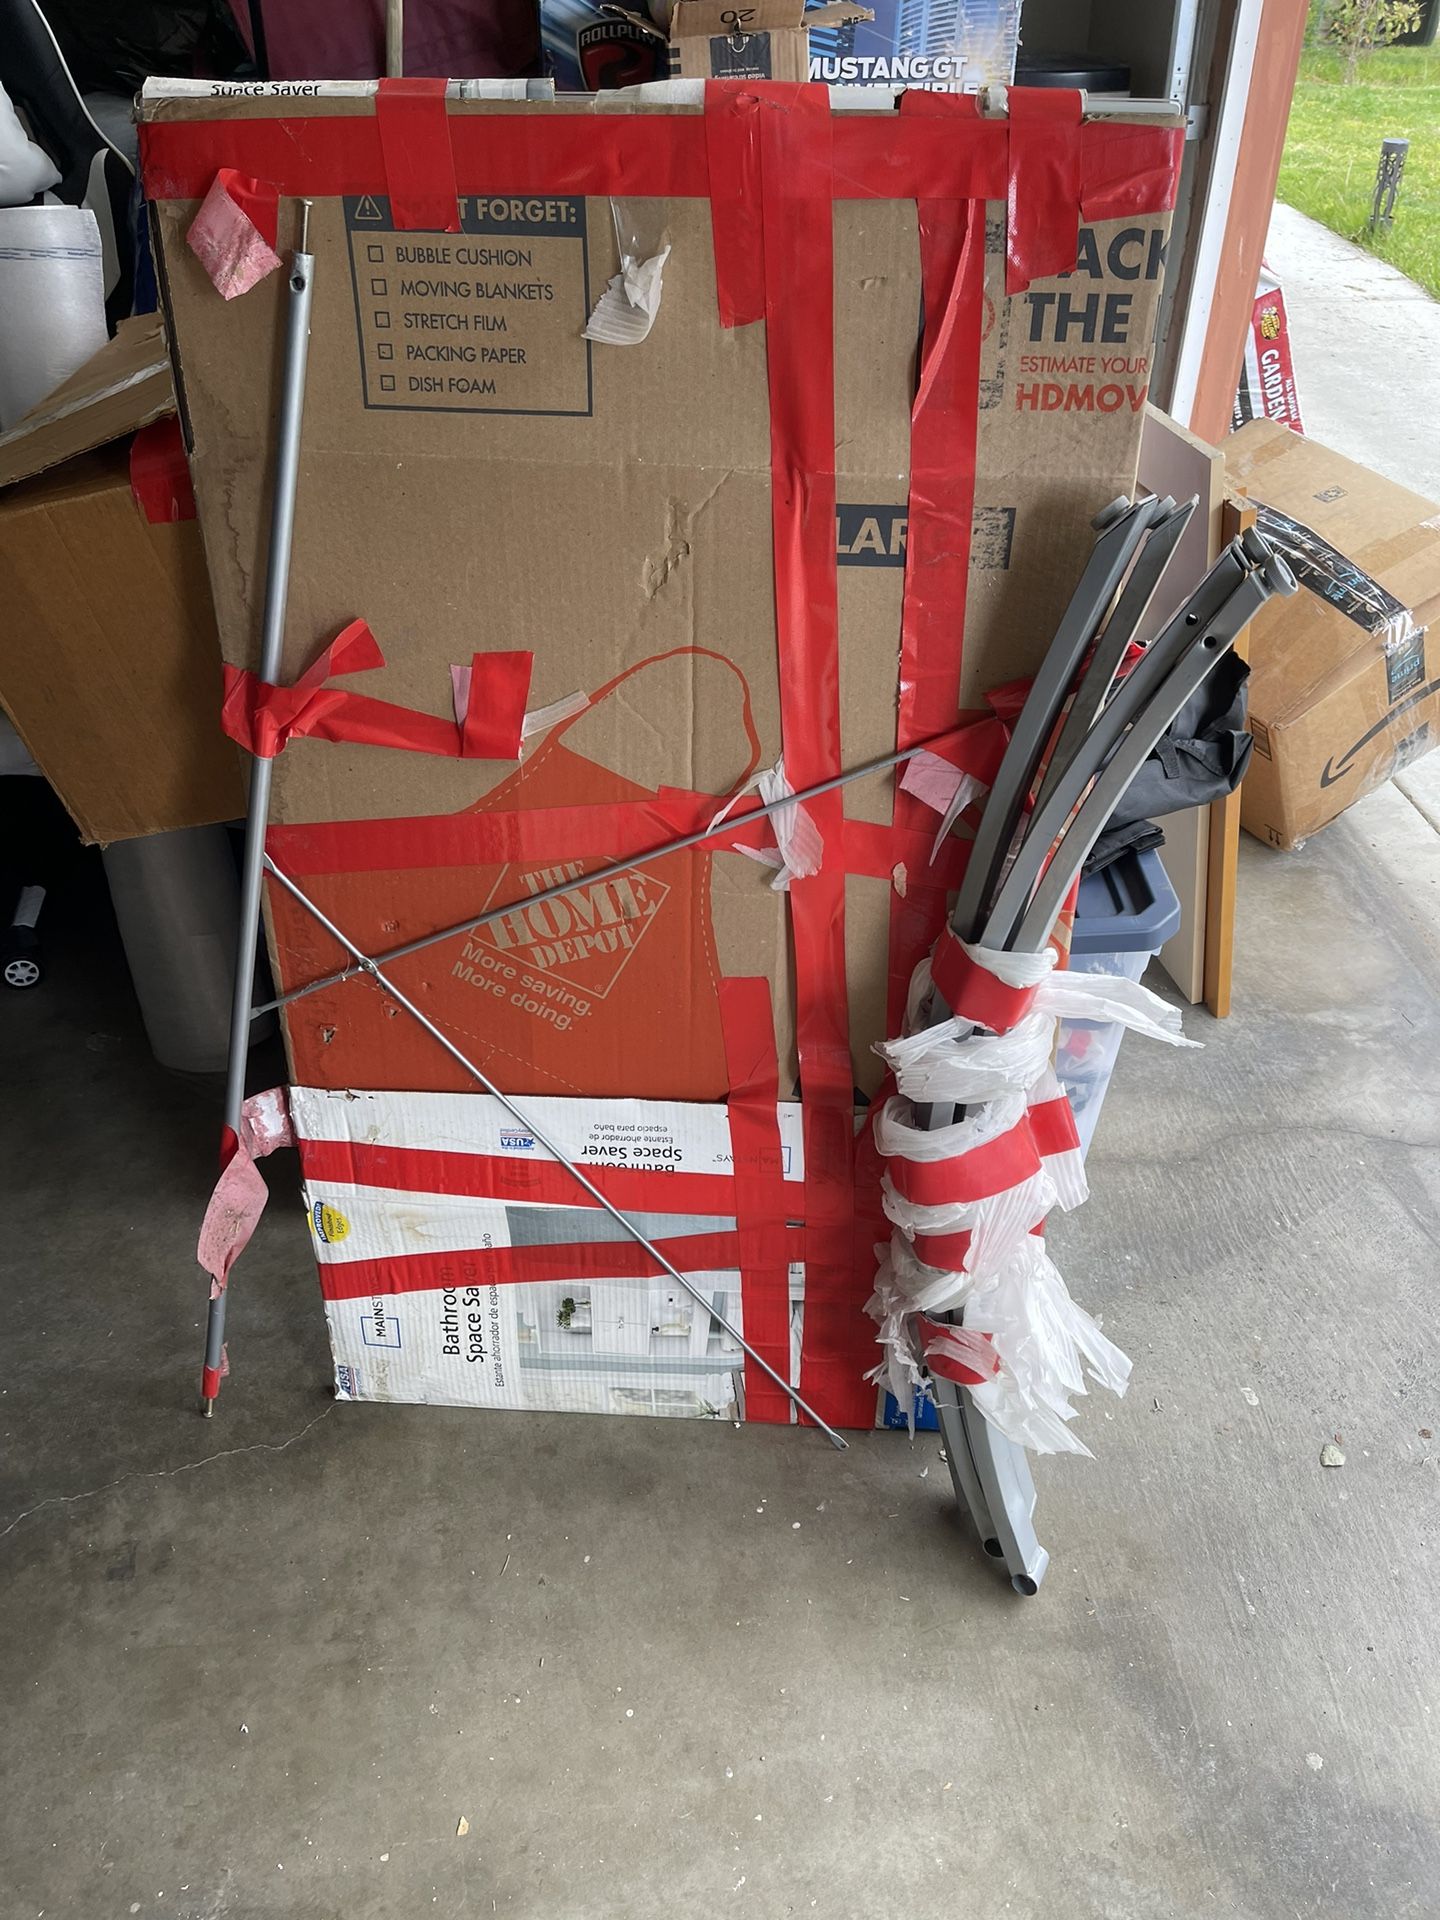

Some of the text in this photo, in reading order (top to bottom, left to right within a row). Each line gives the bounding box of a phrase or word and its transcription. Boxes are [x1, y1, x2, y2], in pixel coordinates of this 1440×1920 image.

[809, 56, 969, 80] MUSTANG GT
[270, 83, 322, 96] Saver
[476, 198, 578, 223] FORGET:
[396, 246, 533, 267] BUBBLE CUSHION
[1057, 227, 1168, 281] ACK
[401, 279, 554, 301] MOVING BLANKETS
[403, 312, 507, 332] STRETCH FILM
[1025, 292, 1133, 344] THE
[406, 345, 527, 364] PACKING PAPER
[1019, 355, 1148, 375] ESTIMATE YOUR
[409, 376, 497, 394] DISH FOAM
[1260, 348, 1288, 421] GARDEN
[1016, 383, 1150, 413] HDMOV
[836, 516, 910, 556] LAR
[518, 860, 585, 894] THE
[485, 872, 657, 950] HOME
[529, 923, 635, 970] DEPOT
[461, 941, 593, 1017] More saving.
[451, 960, 574, 1031] More doing.
[588, 1133, 674, 1144] Estante ahorrador de
[617, 1124, 636, 1132] para
[637, 1125, 668, 1133] espacio
[502, 1137, 524, 1147] USA
[581, 1145, 683, 1162] Space Saver
[481, 1232, 493, 1252] año
[371, 1290, 387, 1338] MAINST
[489, 1307, 499, 1320] de
[466, 1312, 488, 1363] Space
[489, 1322, 502, 1362] ahorrador
[494, 1362, 505, 1388] Estante
